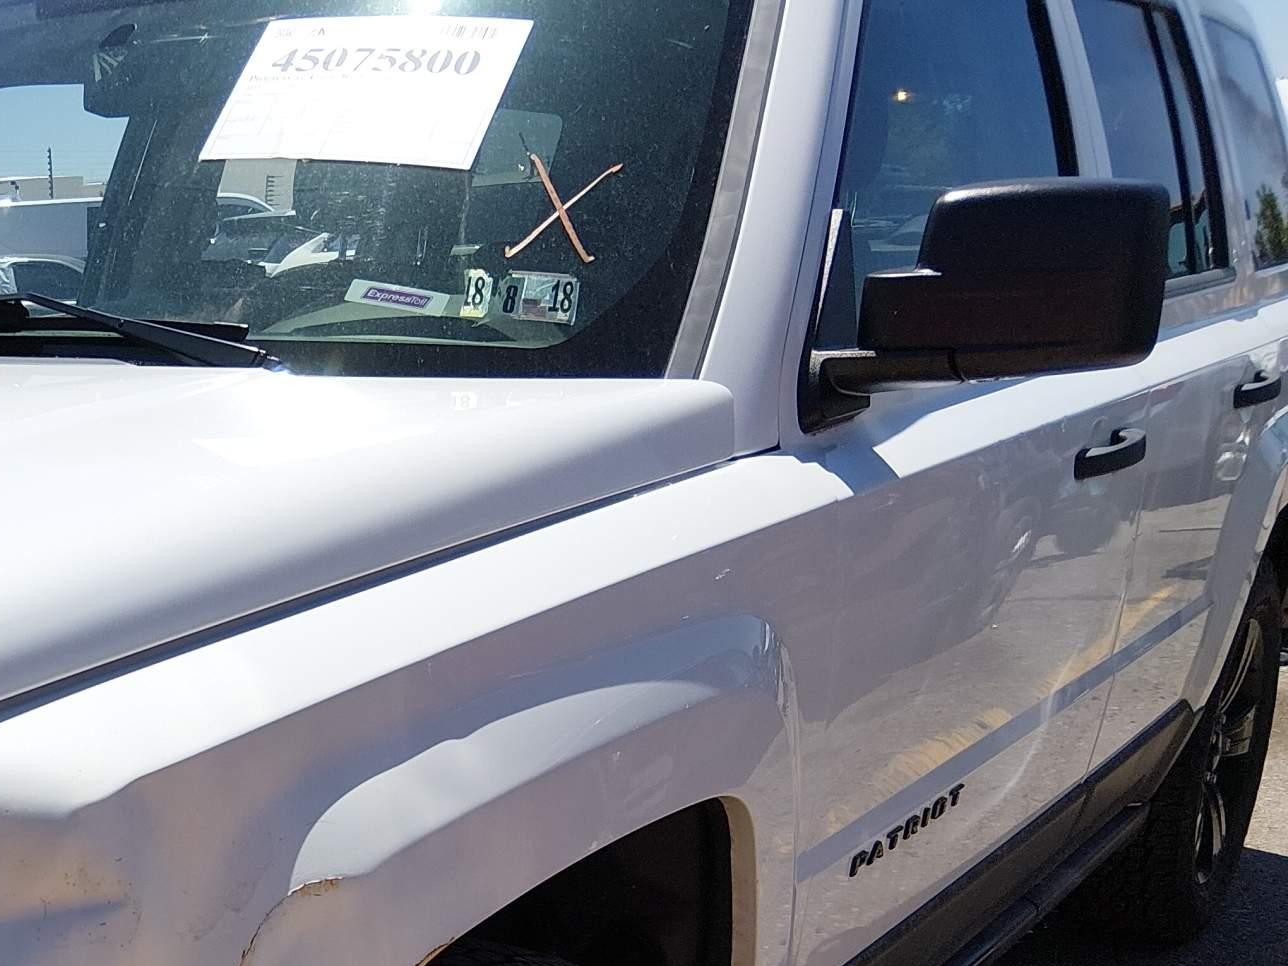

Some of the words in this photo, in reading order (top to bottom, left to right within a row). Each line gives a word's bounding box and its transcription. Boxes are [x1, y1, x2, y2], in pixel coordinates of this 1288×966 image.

[271, 47, 481, 75] 45075800
[464, 277, 486, 306] 18
[502, 285, 519, 313] 8
[548, 279, 574, 313] 18
[848, 783, 966, 878] PATRIOT
